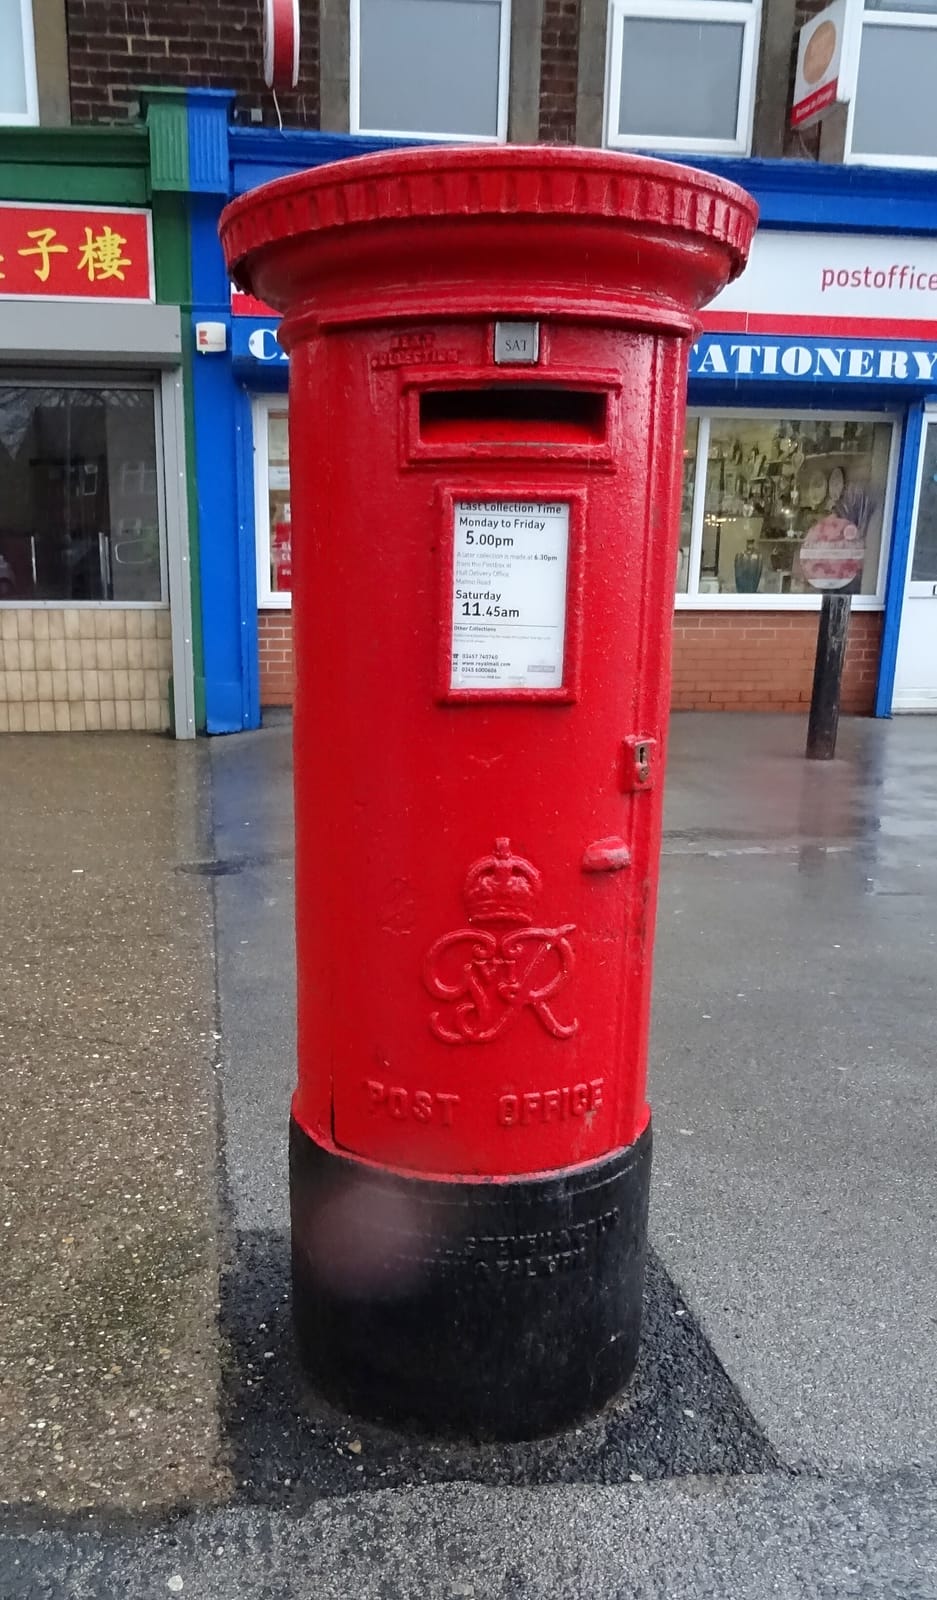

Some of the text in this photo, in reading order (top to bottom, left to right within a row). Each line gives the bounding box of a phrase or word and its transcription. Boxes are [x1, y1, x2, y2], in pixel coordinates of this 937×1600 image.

[0, 226, 132, 282] 子樓
[505, 339, 528, 352] SAT
[460, 502, 562, 514] Last Collection Time
[459, 517, 546, 531] Monday to Friday
[465, 530, 514, 548] 5.00pm
[456, 589, 502, 602] Saturday
[462, 602, 519, 617] 11.45am
[365, 1078, 605, 1127] POST OFFICE
